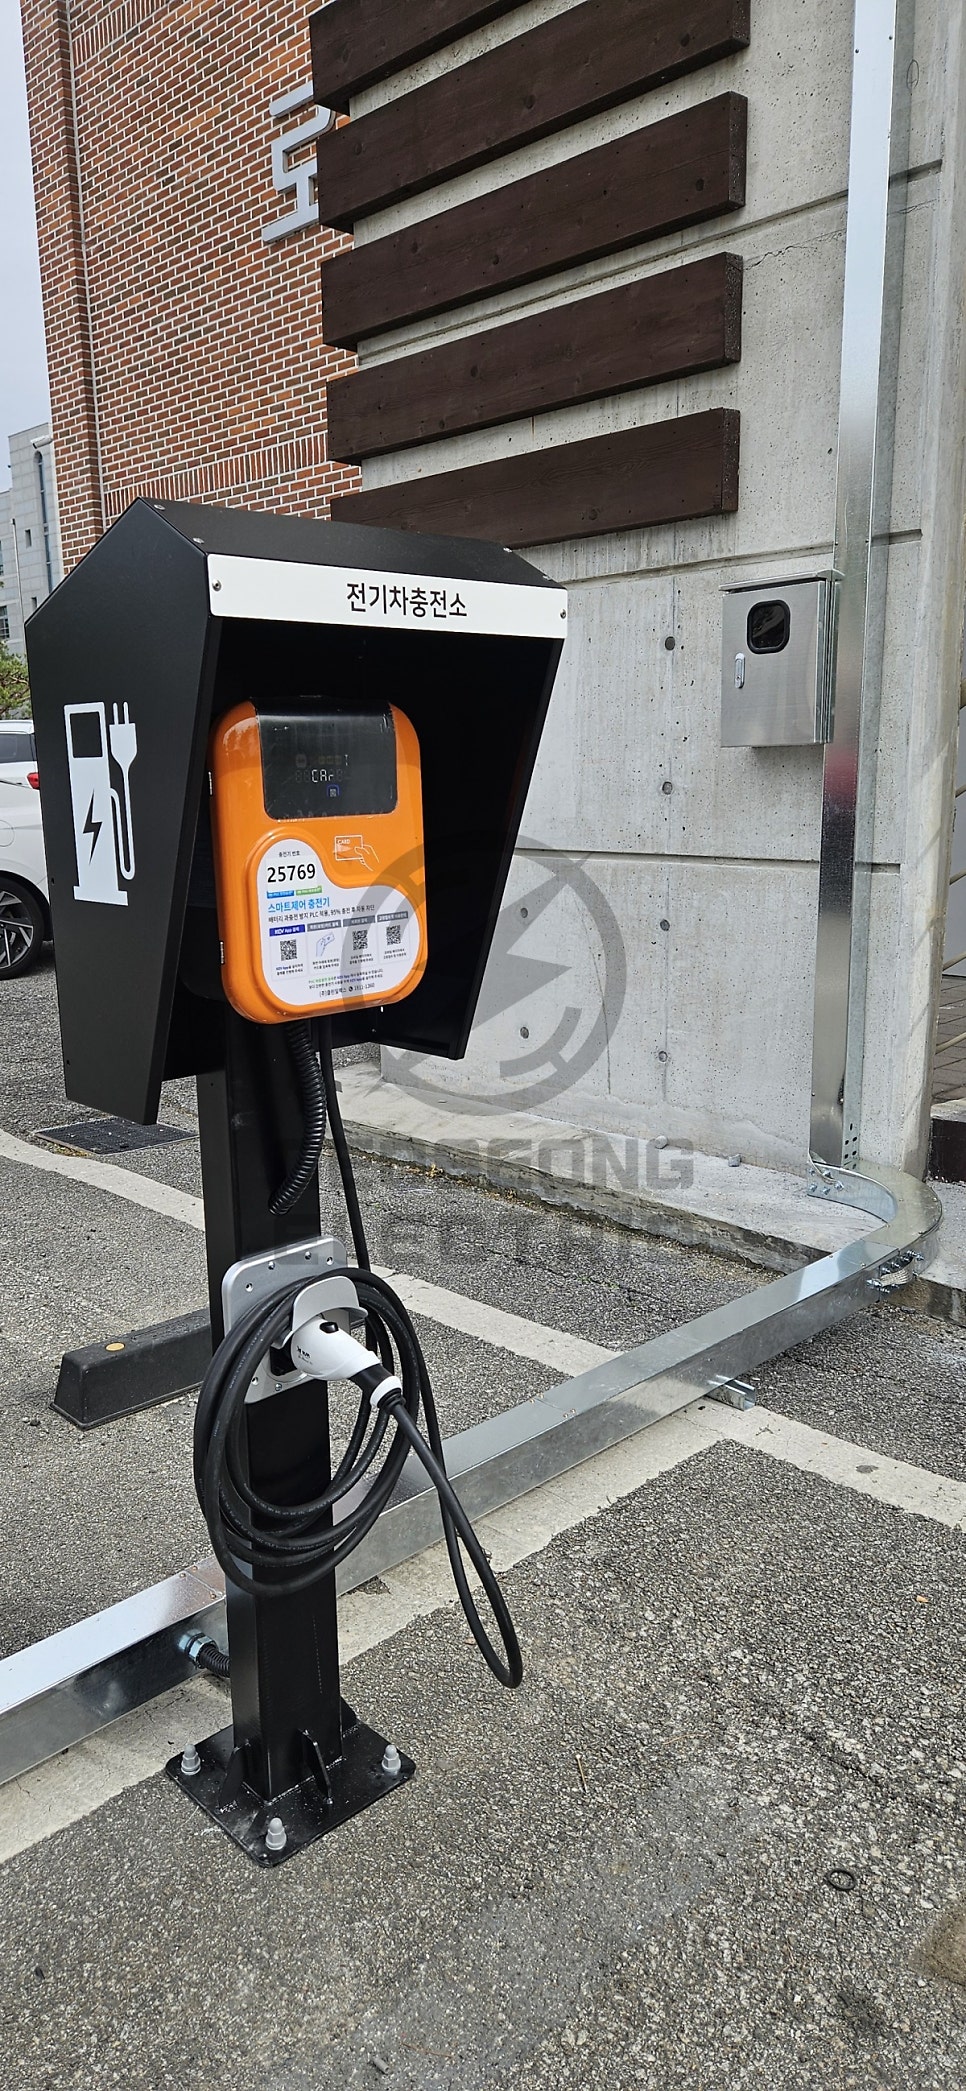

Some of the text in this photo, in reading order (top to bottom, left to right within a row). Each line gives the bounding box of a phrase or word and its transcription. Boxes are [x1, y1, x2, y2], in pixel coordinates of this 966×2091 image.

[346, 582, 468, 619] 전기차충전소
[267, 863, 316, 883] 25769
[268, 897, 330, 913] 스마트제어 충전기
